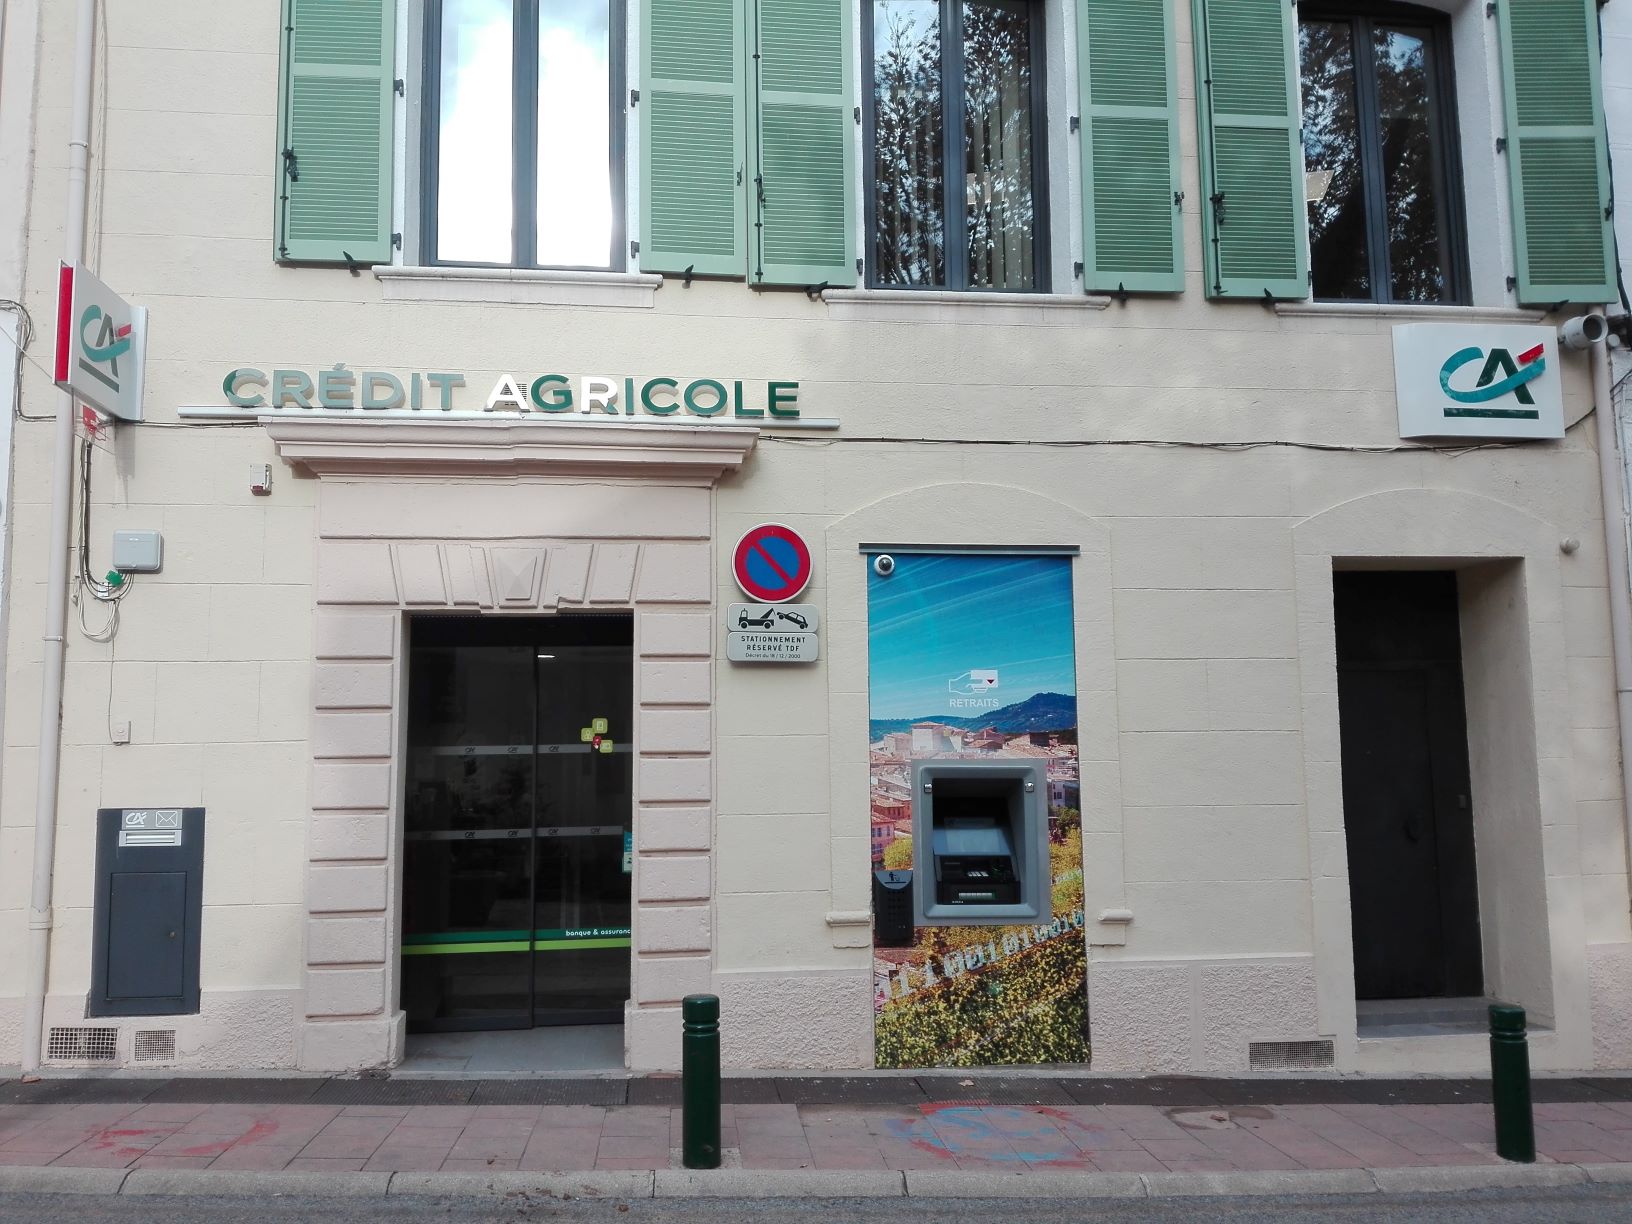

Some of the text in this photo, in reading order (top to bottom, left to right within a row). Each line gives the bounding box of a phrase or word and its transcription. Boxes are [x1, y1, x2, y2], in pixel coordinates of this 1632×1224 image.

[223, 362, 800, 417] CRÉDIT AGRICOLE
[746, 643, 783, 651] RÉSERVÉ
[949, 698, 999, 708] RETRAITS
